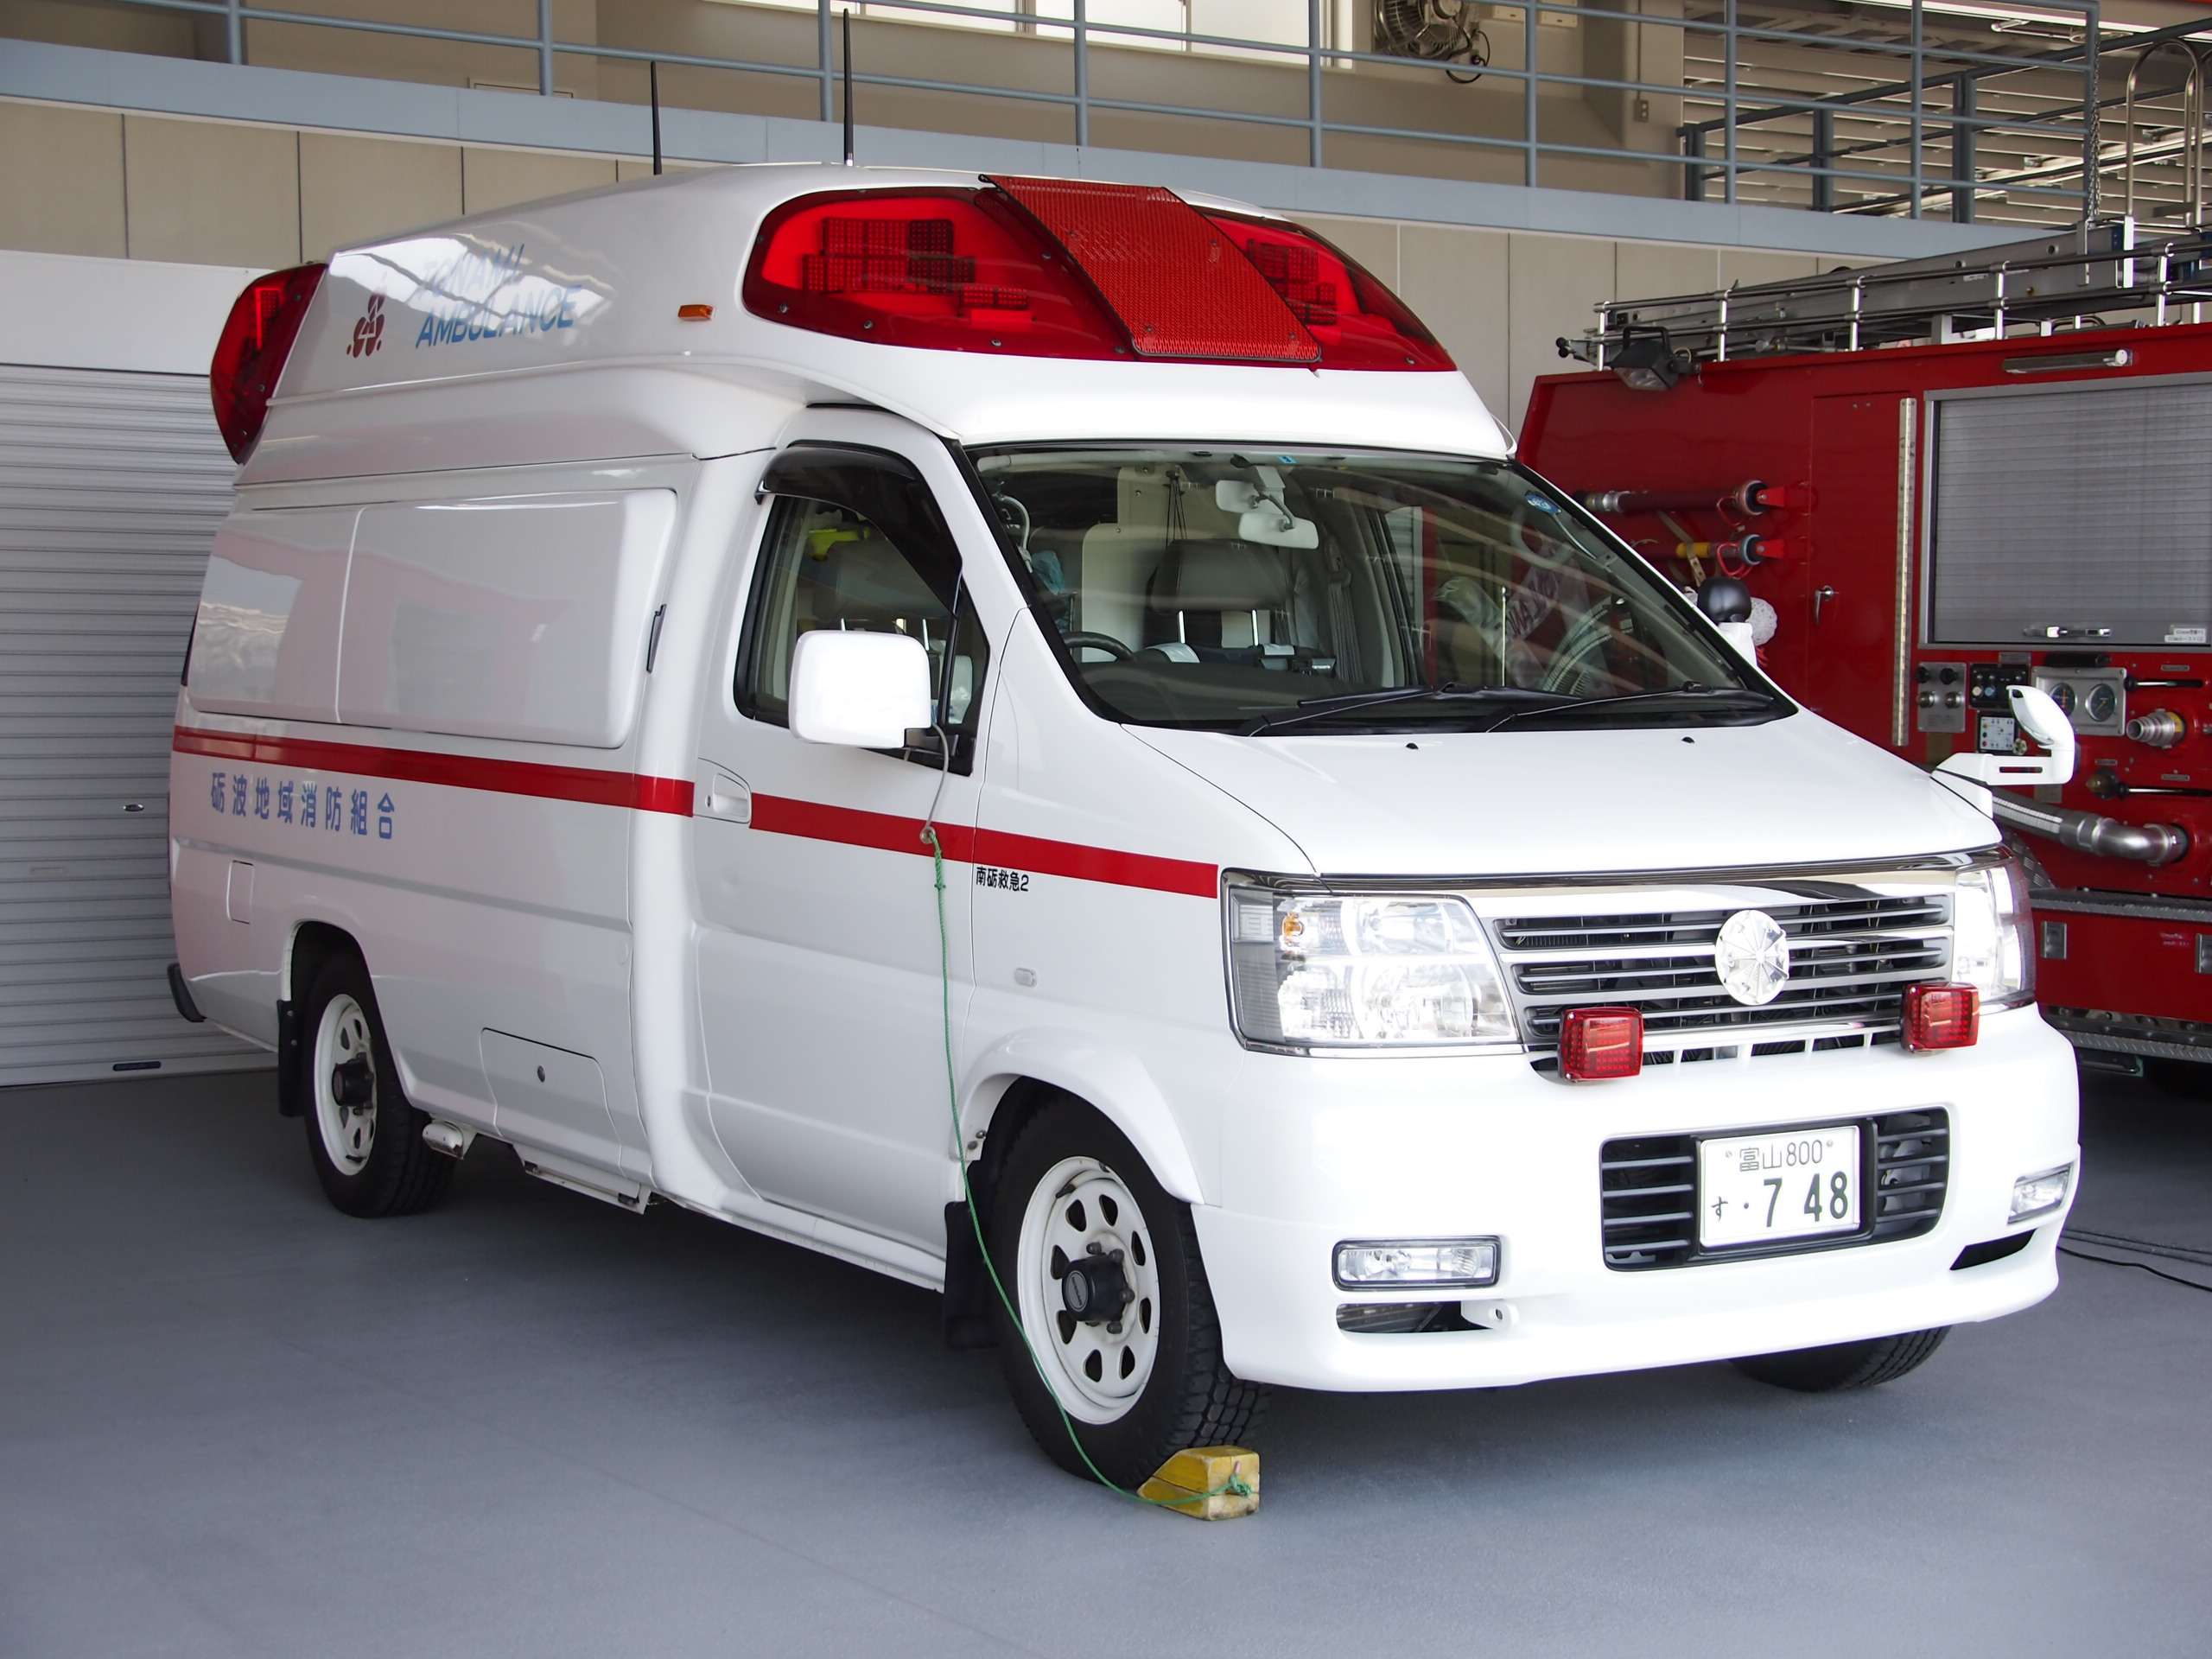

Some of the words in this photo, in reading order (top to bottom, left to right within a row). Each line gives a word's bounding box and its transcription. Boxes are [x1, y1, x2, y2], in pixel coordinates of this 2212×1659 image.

[416, 285, 582, 348] AMBULANCE
[211, 772, 395, 839] 砺波地域消防組合
[976, 866, 1029, 892] 南砺救急2
[1739, 1140, 1822, 1172] 富山800
